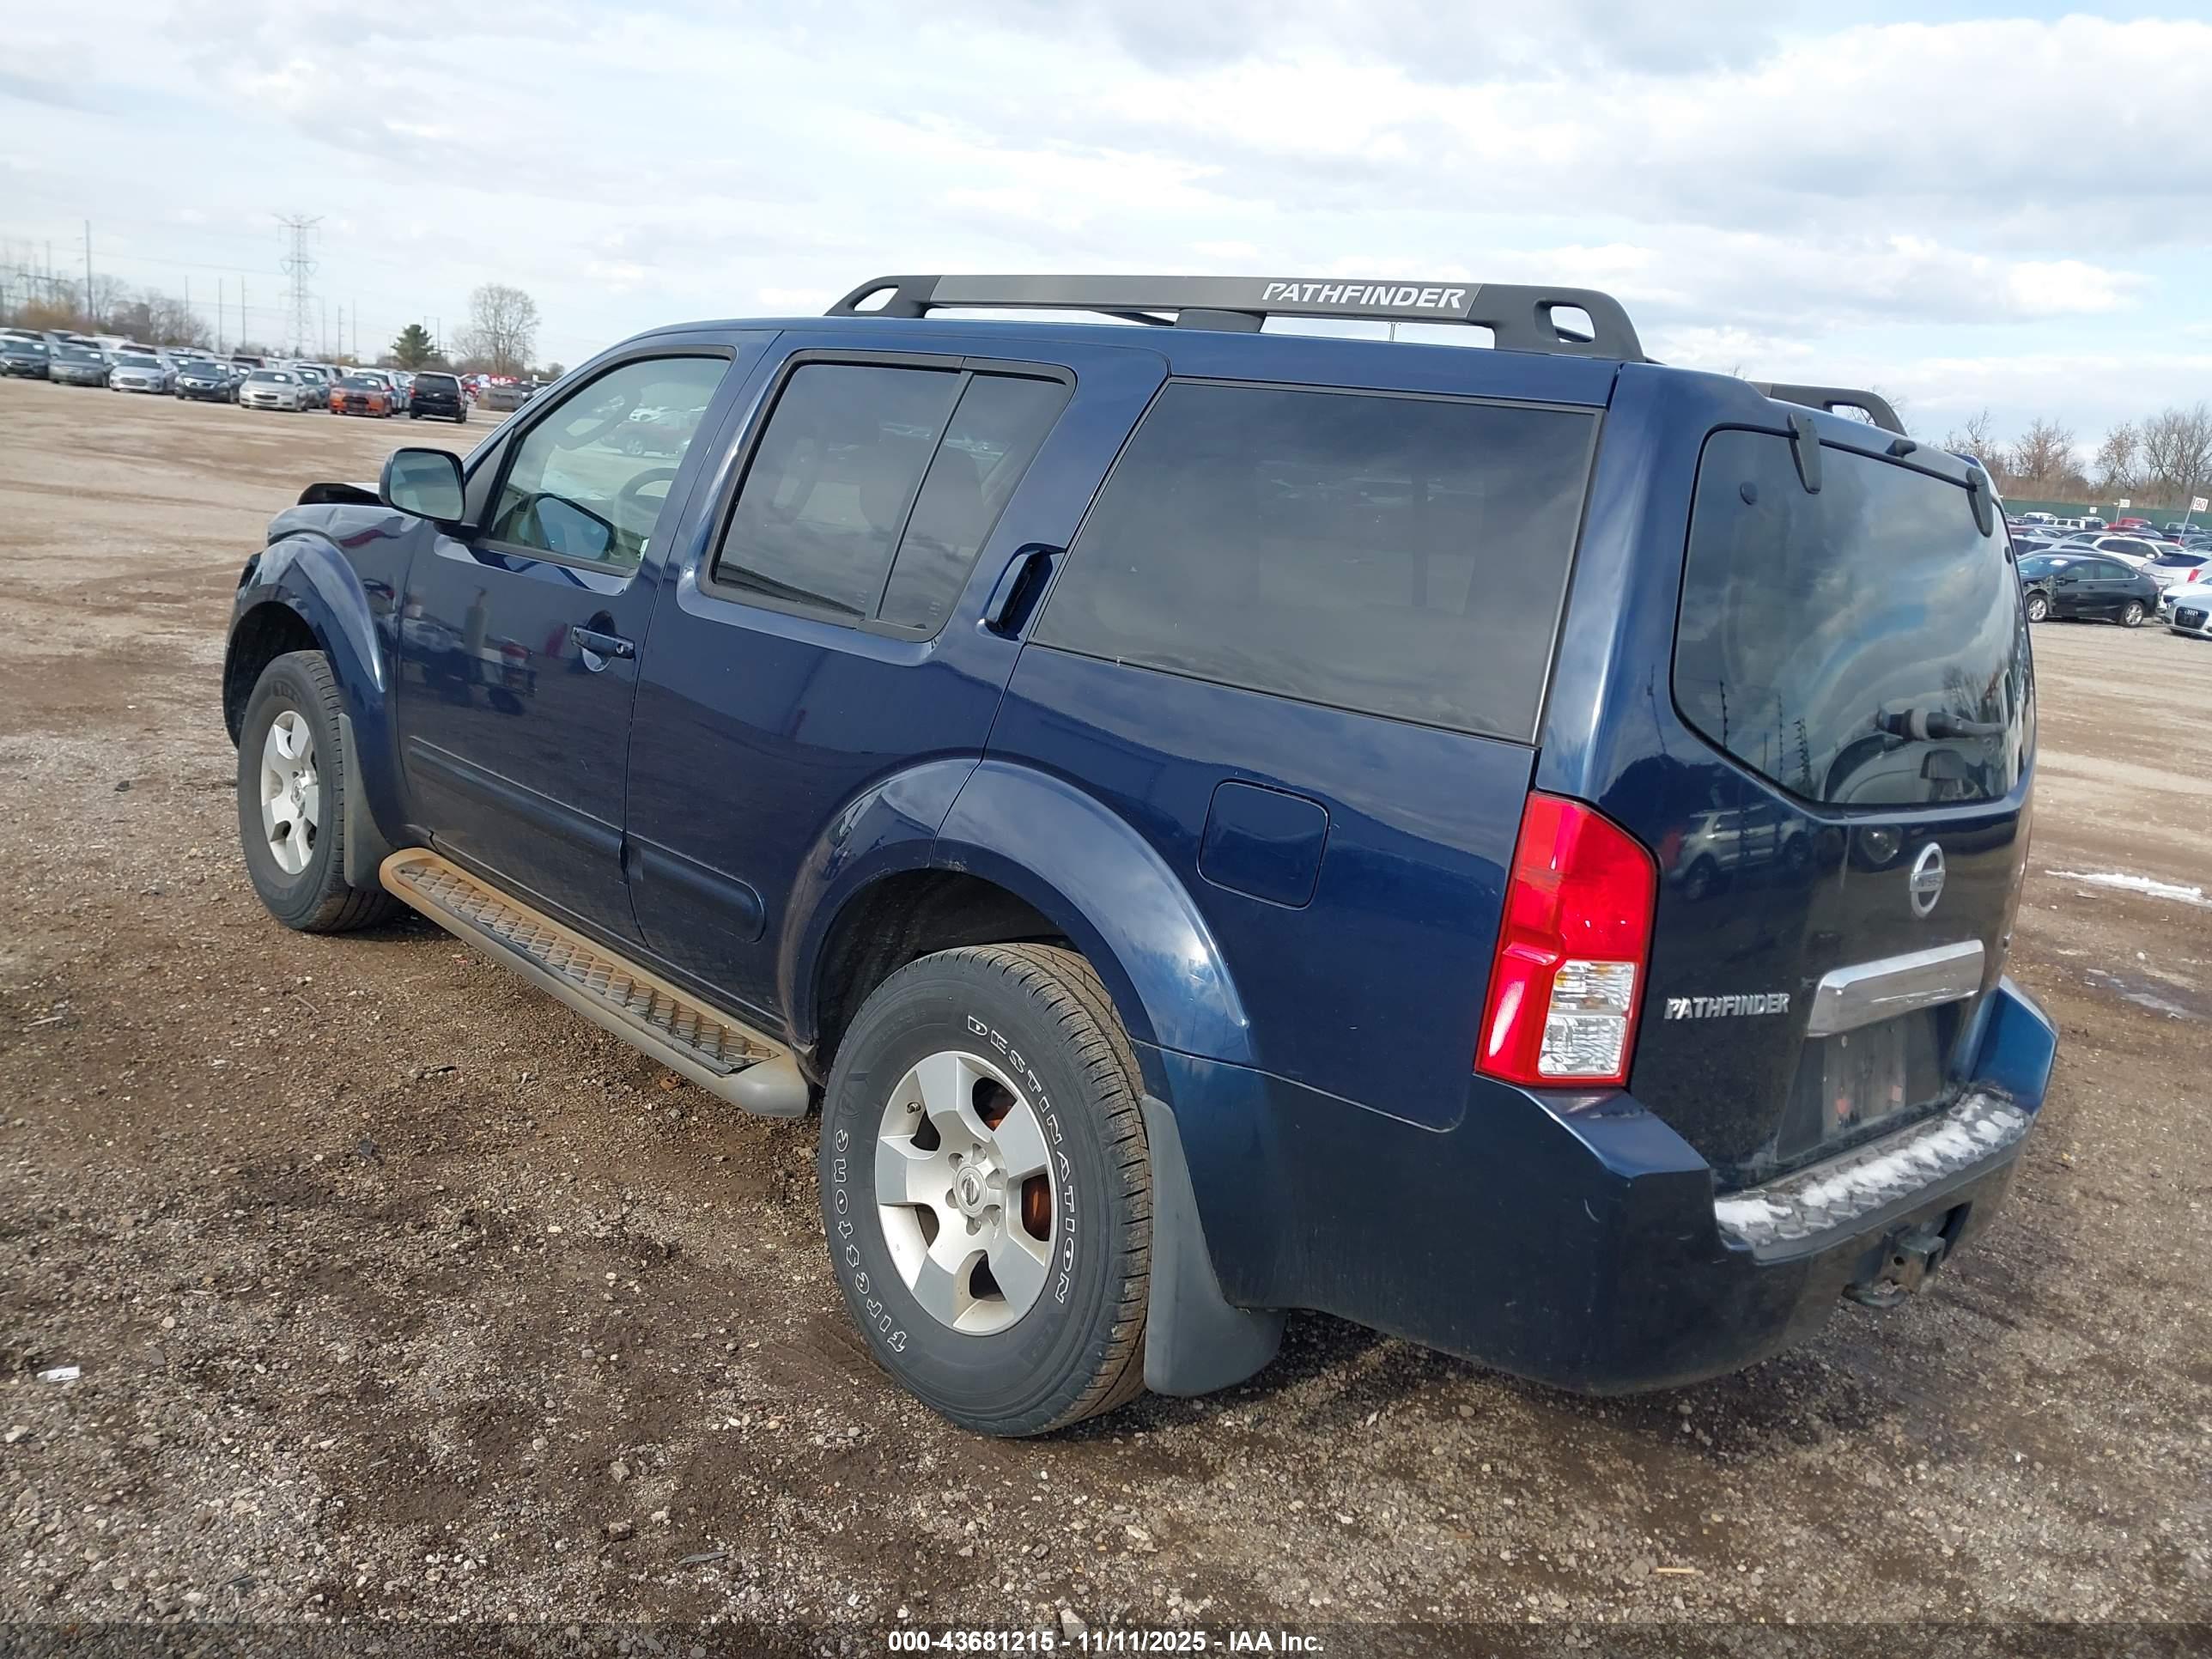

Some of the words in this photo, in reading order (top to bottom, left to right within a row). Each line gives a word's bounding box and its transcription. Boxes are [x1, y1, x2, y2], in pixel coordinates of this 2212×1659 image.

[1262, 283, 1466, 308] PATHFINDER
[1664, 993, 1790, 1019] PATHFINDER
[967, 1014, 1077, 1304] DESTINATION
